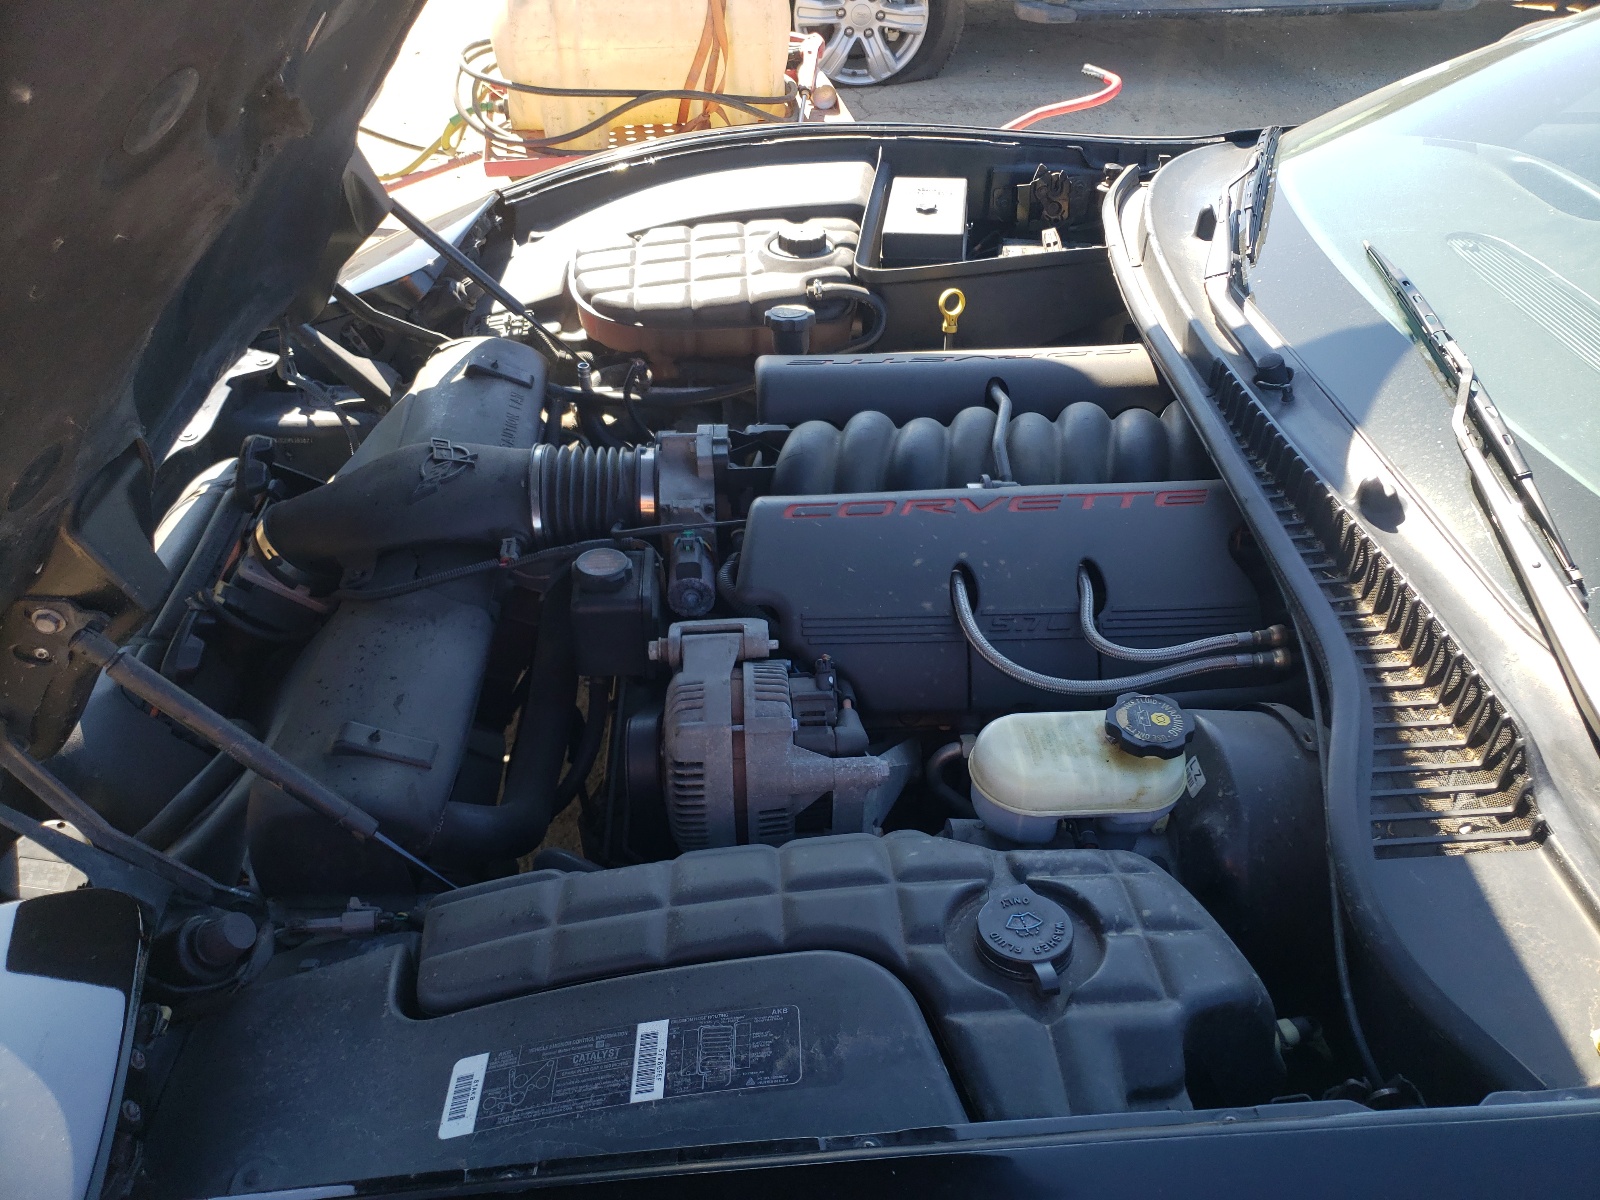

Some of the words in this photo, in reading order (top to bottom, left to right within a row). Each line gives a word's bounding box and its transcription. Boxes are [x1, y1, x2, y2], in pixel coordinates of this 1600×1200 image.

[783, 489, 1209, 520] CORVETTE
[989, 932, 1023, 954] FLUID
[1032, 921, 1065, 954] WASHER
[771, 1008, 789, 1016] AKB
[573, 1048, 621, 1064] CATALYST
